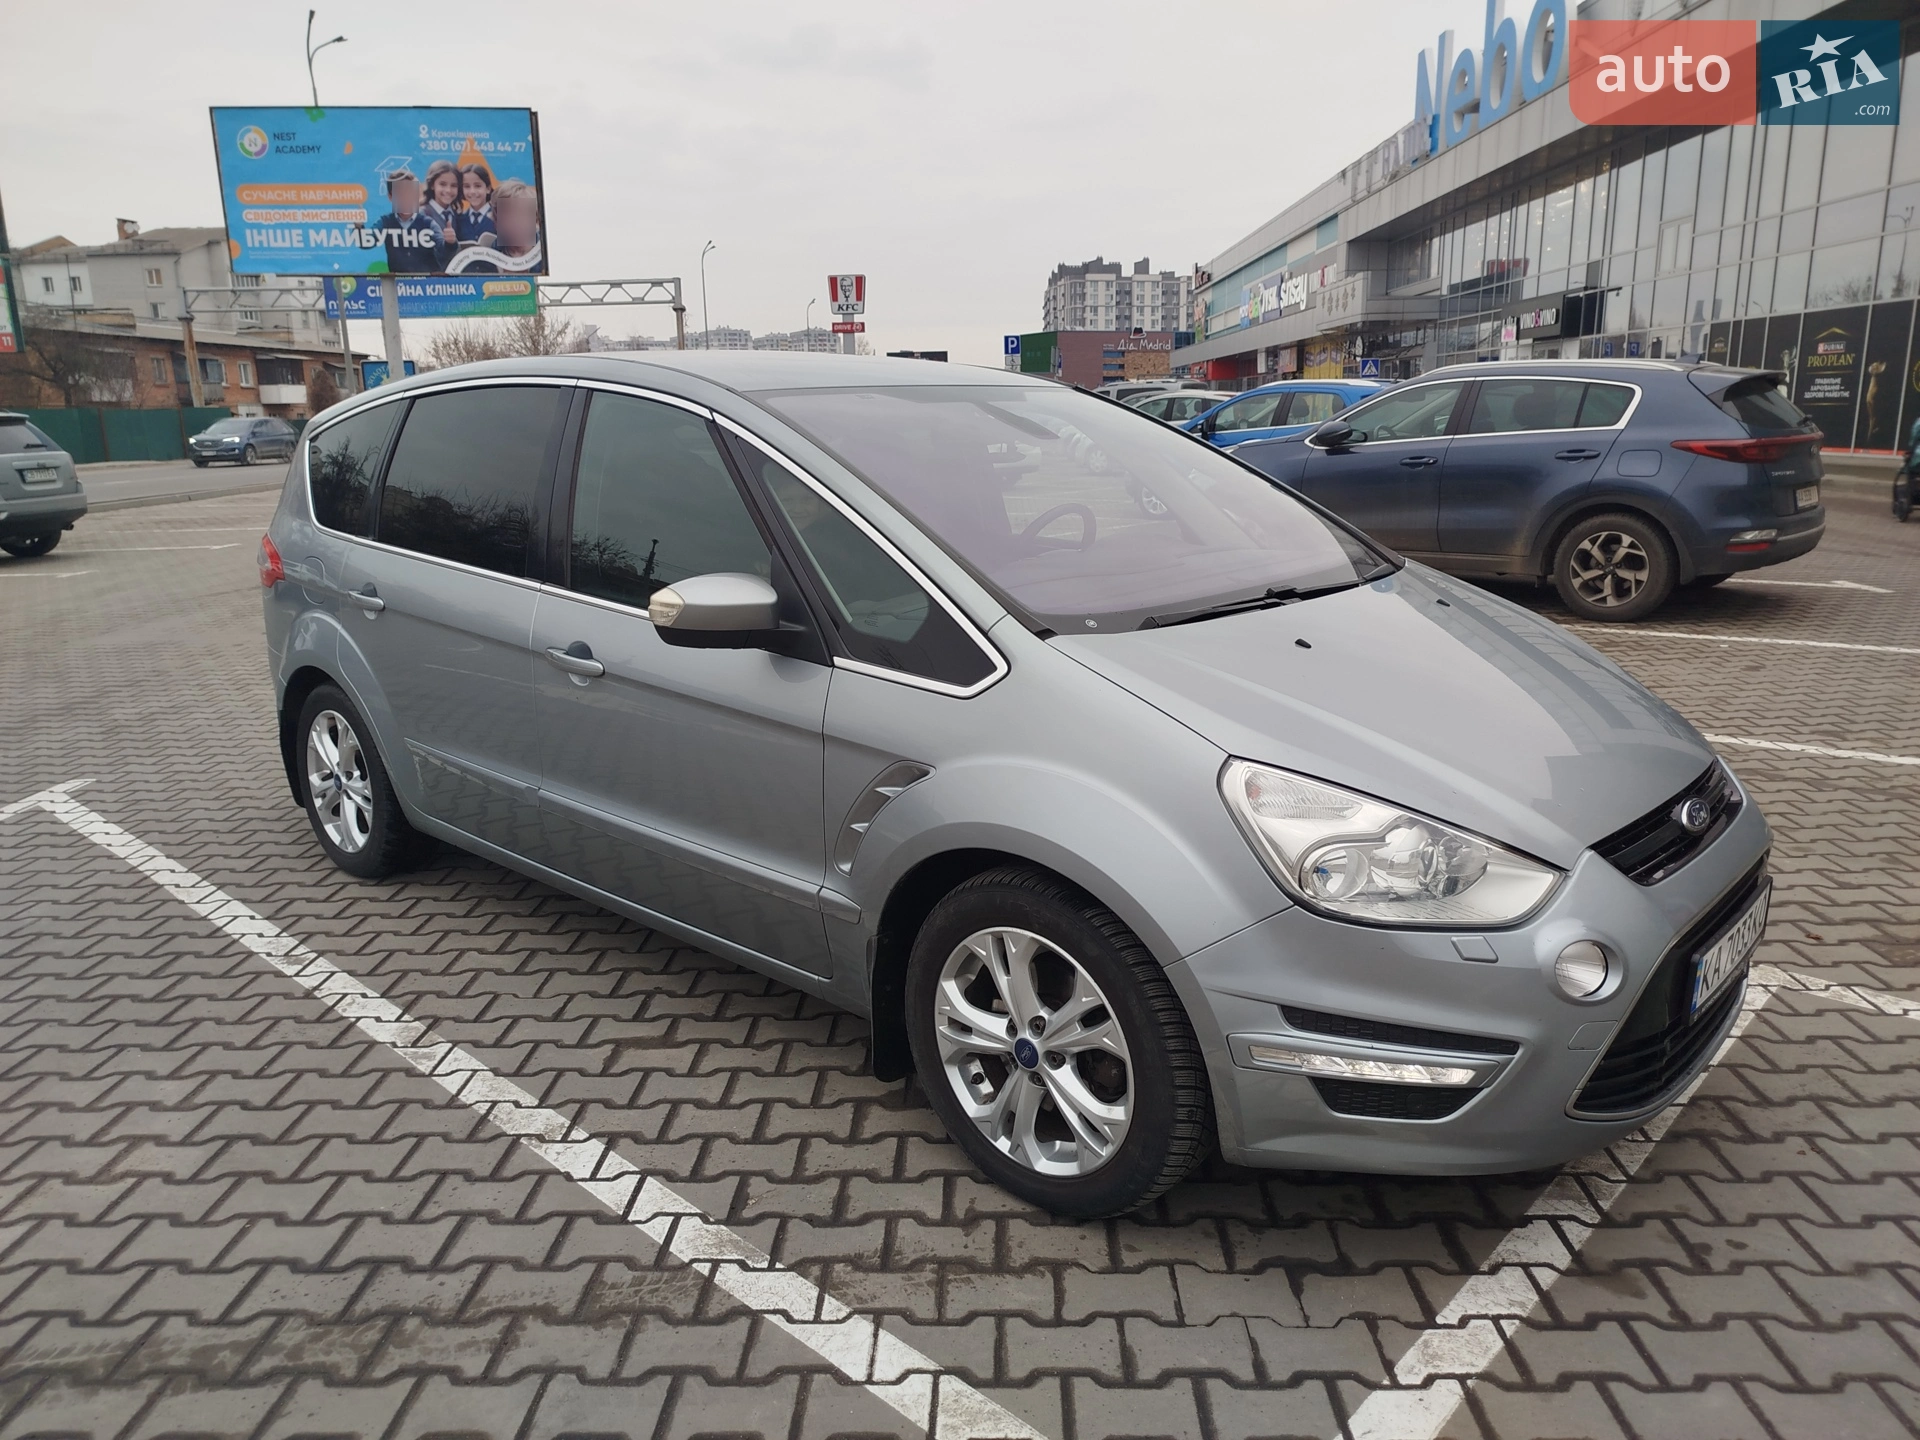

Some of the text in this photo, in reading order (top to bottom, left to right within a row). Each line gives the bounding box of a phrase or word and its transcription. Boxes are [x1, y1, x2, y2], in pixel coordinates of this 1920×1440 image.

[1414, 0, 1567, 147] Nebo
[273, 132, 296, 141] NEST
[431, 129, 490, 140] Крюківщина
[275, 145, 322, 155] ACADEMY
[419, 139, 527, 152] +380 (67) 448 44 77
[242, 189, 364, 201] СУЧАСНЕ НАВЧАННЯ
[243, 209, 366, 224] СВІДОМЕ МИСЛЕННЯ
[245, 223, 436, 249] ІНШЕ МАЙБУТНЄ
[366, 282, 477, 298] СІЙНА КЛІНІКА
[488, 283, 527, 293] PULS.UA
[1280, 272, 1308, 311] sinsay
[837, 303, 859, 312] KFC
[1008, 337, 1017, 354] P
[1824, 343, 1844, 351] PURINA
[1807, 354, 1854, 368] PRO PLAN
[1690, 803, 1708, 826] Ford
